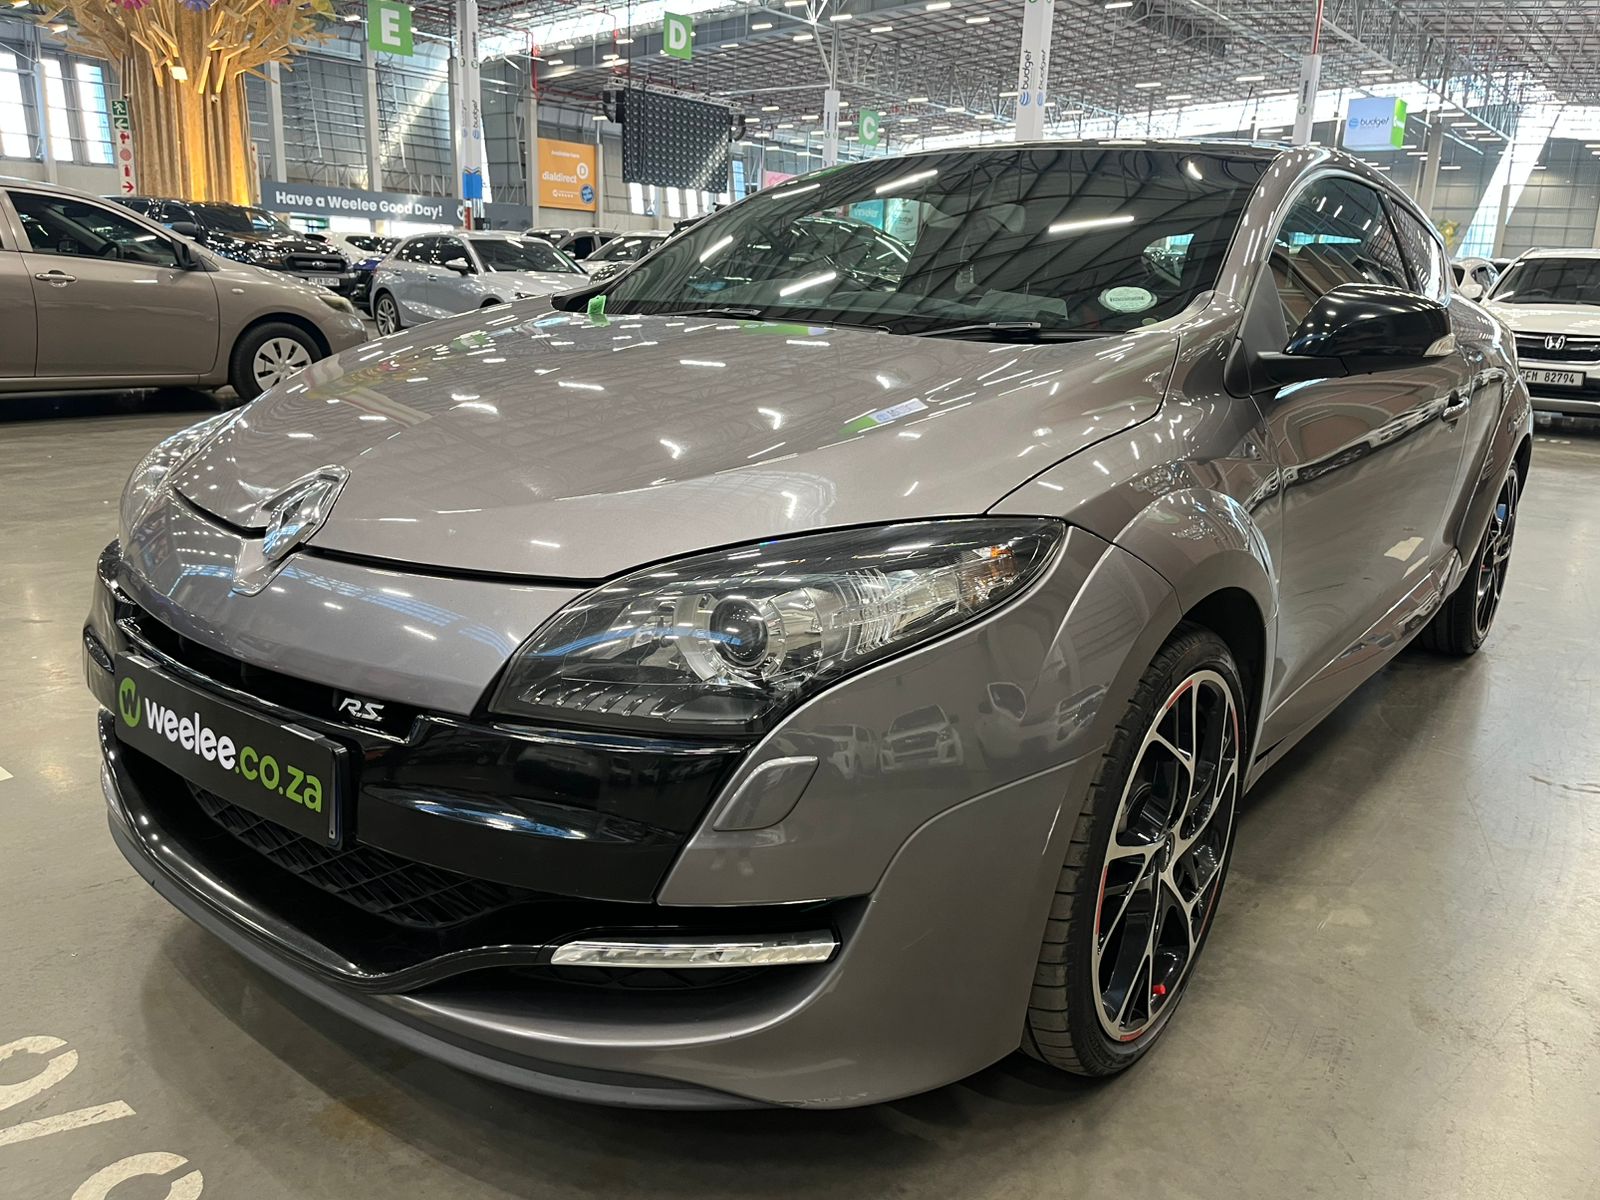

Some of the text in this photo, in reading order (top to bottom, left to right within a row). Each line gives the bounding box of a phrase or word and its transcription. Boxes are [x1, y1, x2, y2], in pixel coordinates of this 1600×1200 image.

[380, 7, 401, 47] E
[669, 19, 687, 50] D
[863, 116, 876, 140] C
[275, 191, 443, 220] Have a Weelee Good Day!
[1544, 372, 1575, 384] 82794
[145, 697, 323, 812] weelee.co.za
